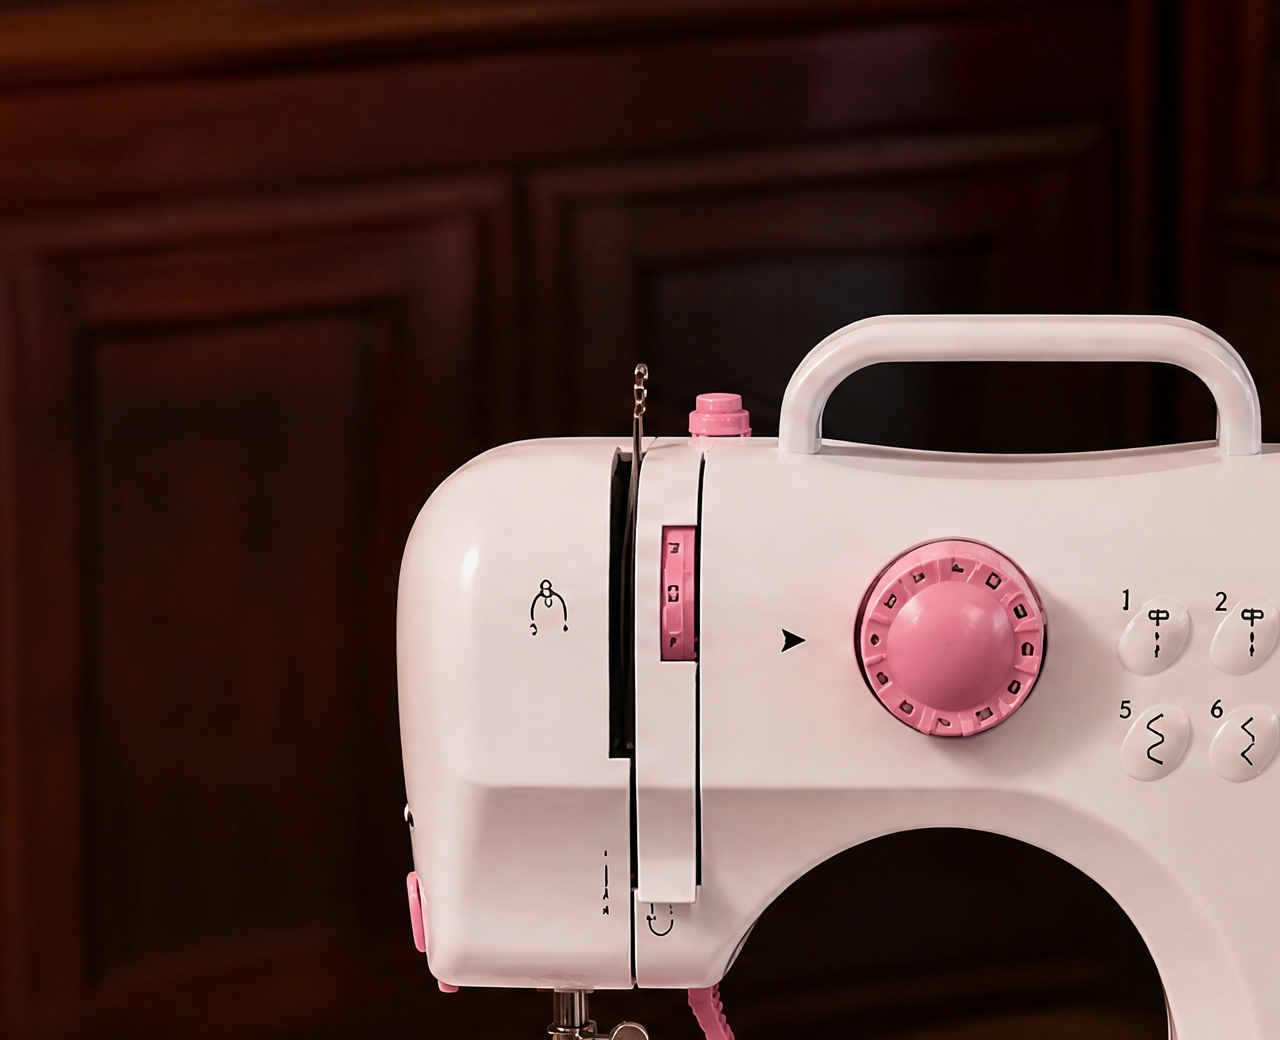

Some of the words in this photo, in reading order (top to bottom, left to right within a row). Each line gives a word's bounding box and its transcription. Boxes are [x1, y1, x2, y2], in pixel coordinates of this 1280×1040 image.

[1122, 588, 1129, 611] 1
[1214, 591, 1228, 612] 2
[1119, 700, 1132, 719] 5
[1210, 699, 1224, 719] 6
